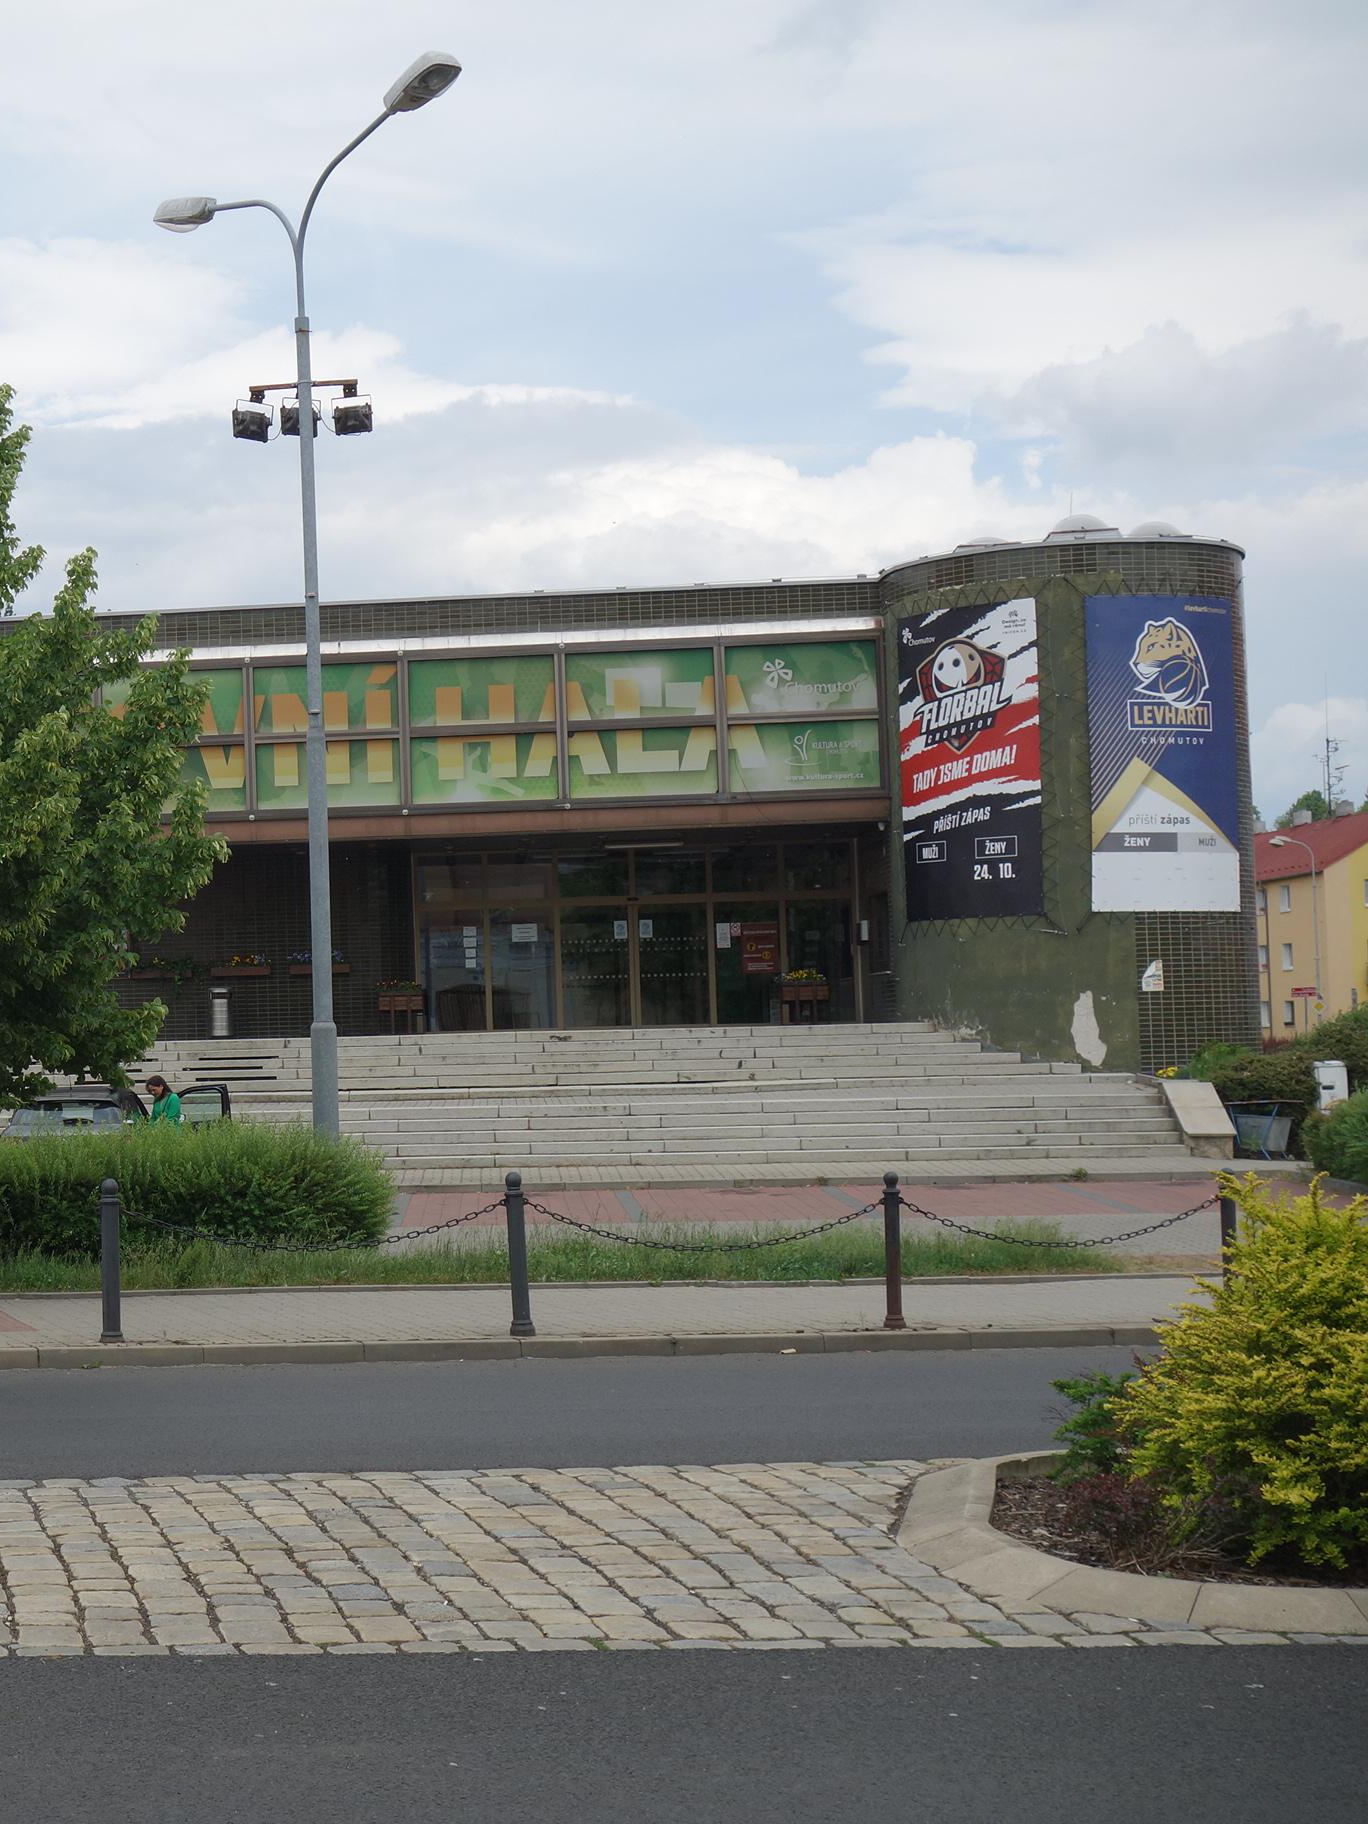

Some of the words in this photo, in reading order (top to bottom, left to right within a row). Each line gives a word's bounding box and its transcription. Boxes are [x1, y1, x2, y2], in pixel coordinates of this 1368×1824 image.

[908, 637, 936, 647] Chomutov
[784, 681, 861, 694] Chomutov
[915, 681, 1011, 734] FLORBAL
[1133, 705, 1209, 726] LEVHARTI
[435, 675, 768, 781] HALA
[927, 717, 993, 744] CHOMUTOV
[1141, 736, 1204, 745] CHOMUTOV
[913, 767, 937, 794] TADY
[938, 756, 970, 785] JSME
[972, 744, 1017, 775] DOMA!
[933, 811, 960, 834] PŘÍŠTÍ
[960, 806, 991, 826] ZÁPAS
[1128, 813, 1158, 827] příští
[1160, 813, 1191, 827] zápas
[985, 840, 1007, 855] ŽENY
[1123, 834, 1151, 847] ŽENY
[1198, 836, 1217, 847] MUŽI
[922, 844, 939, 860] MUŽI
[973, 864, 992, 880] 24.
[999, 862, 1016, 879] 10.
